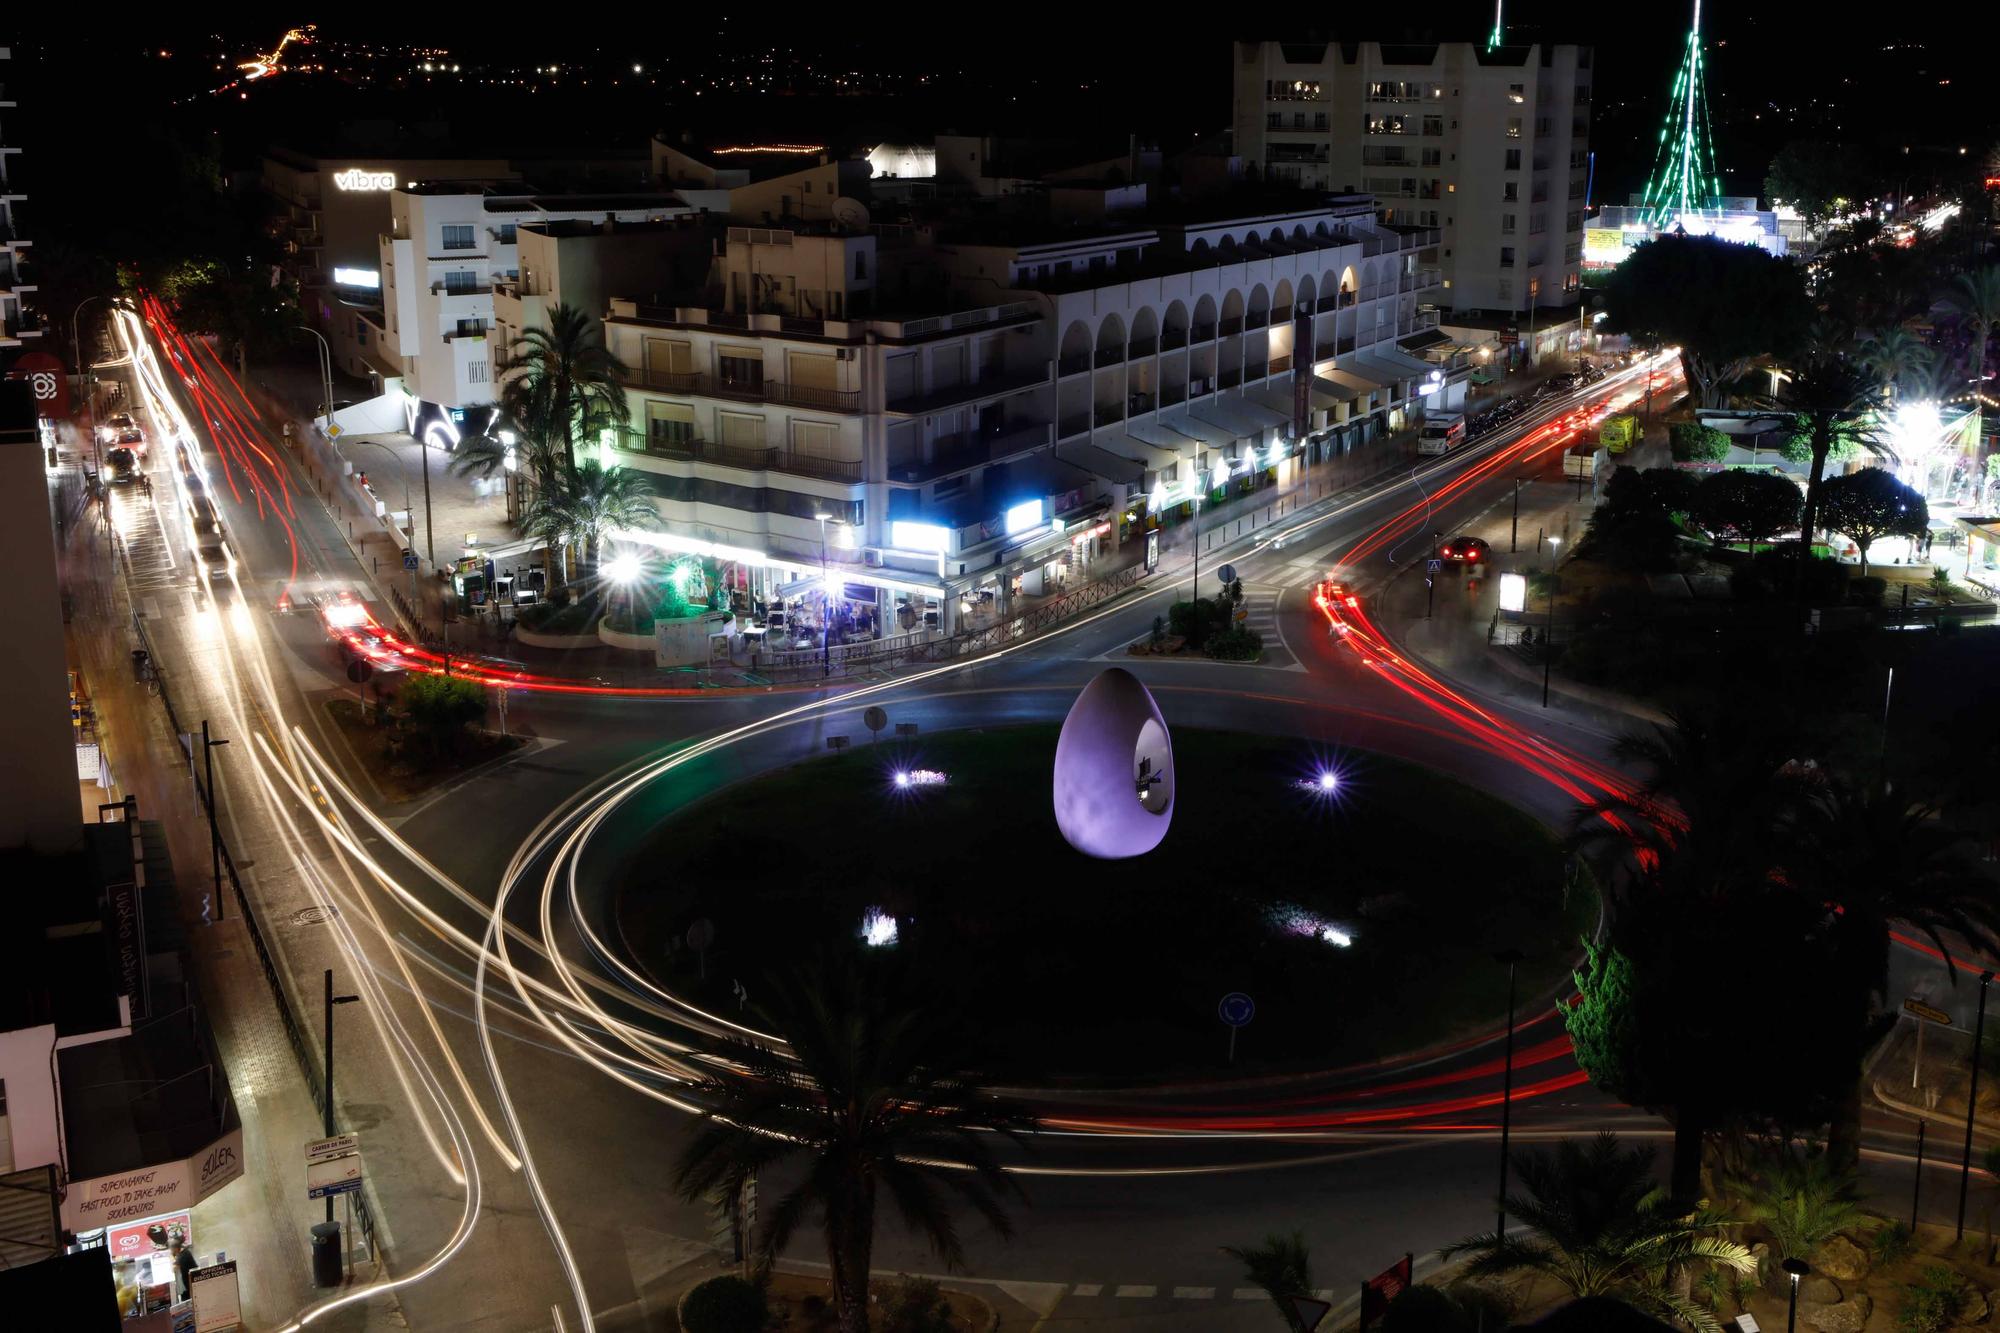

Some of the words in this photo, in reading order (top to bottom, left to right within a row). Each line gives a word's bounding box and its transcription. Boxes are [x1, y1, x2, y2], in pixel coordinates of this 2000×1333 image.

[335, 169, 395, 190] vibra
[202, 1147, 236, 1180] SOLER
[99, 1172, 157, 1193] SUPERMARKET
[80, 1199, 100, 1213] FAST
[100, 1194, 121, 1208] FOOD
[122, 1192, 133, 1203] TO
[133, 1188, 153, 1201] TAKE
[154, 1181, 180, 1195] AWAY
[107, 1201, 154, 1220] SOUVENIRS
[193, 1273, 211, 1282] DISCO
[211, 1268, 234, 1277] TICKETS
[201, 1265, 225, 1275] OFFICIAL
